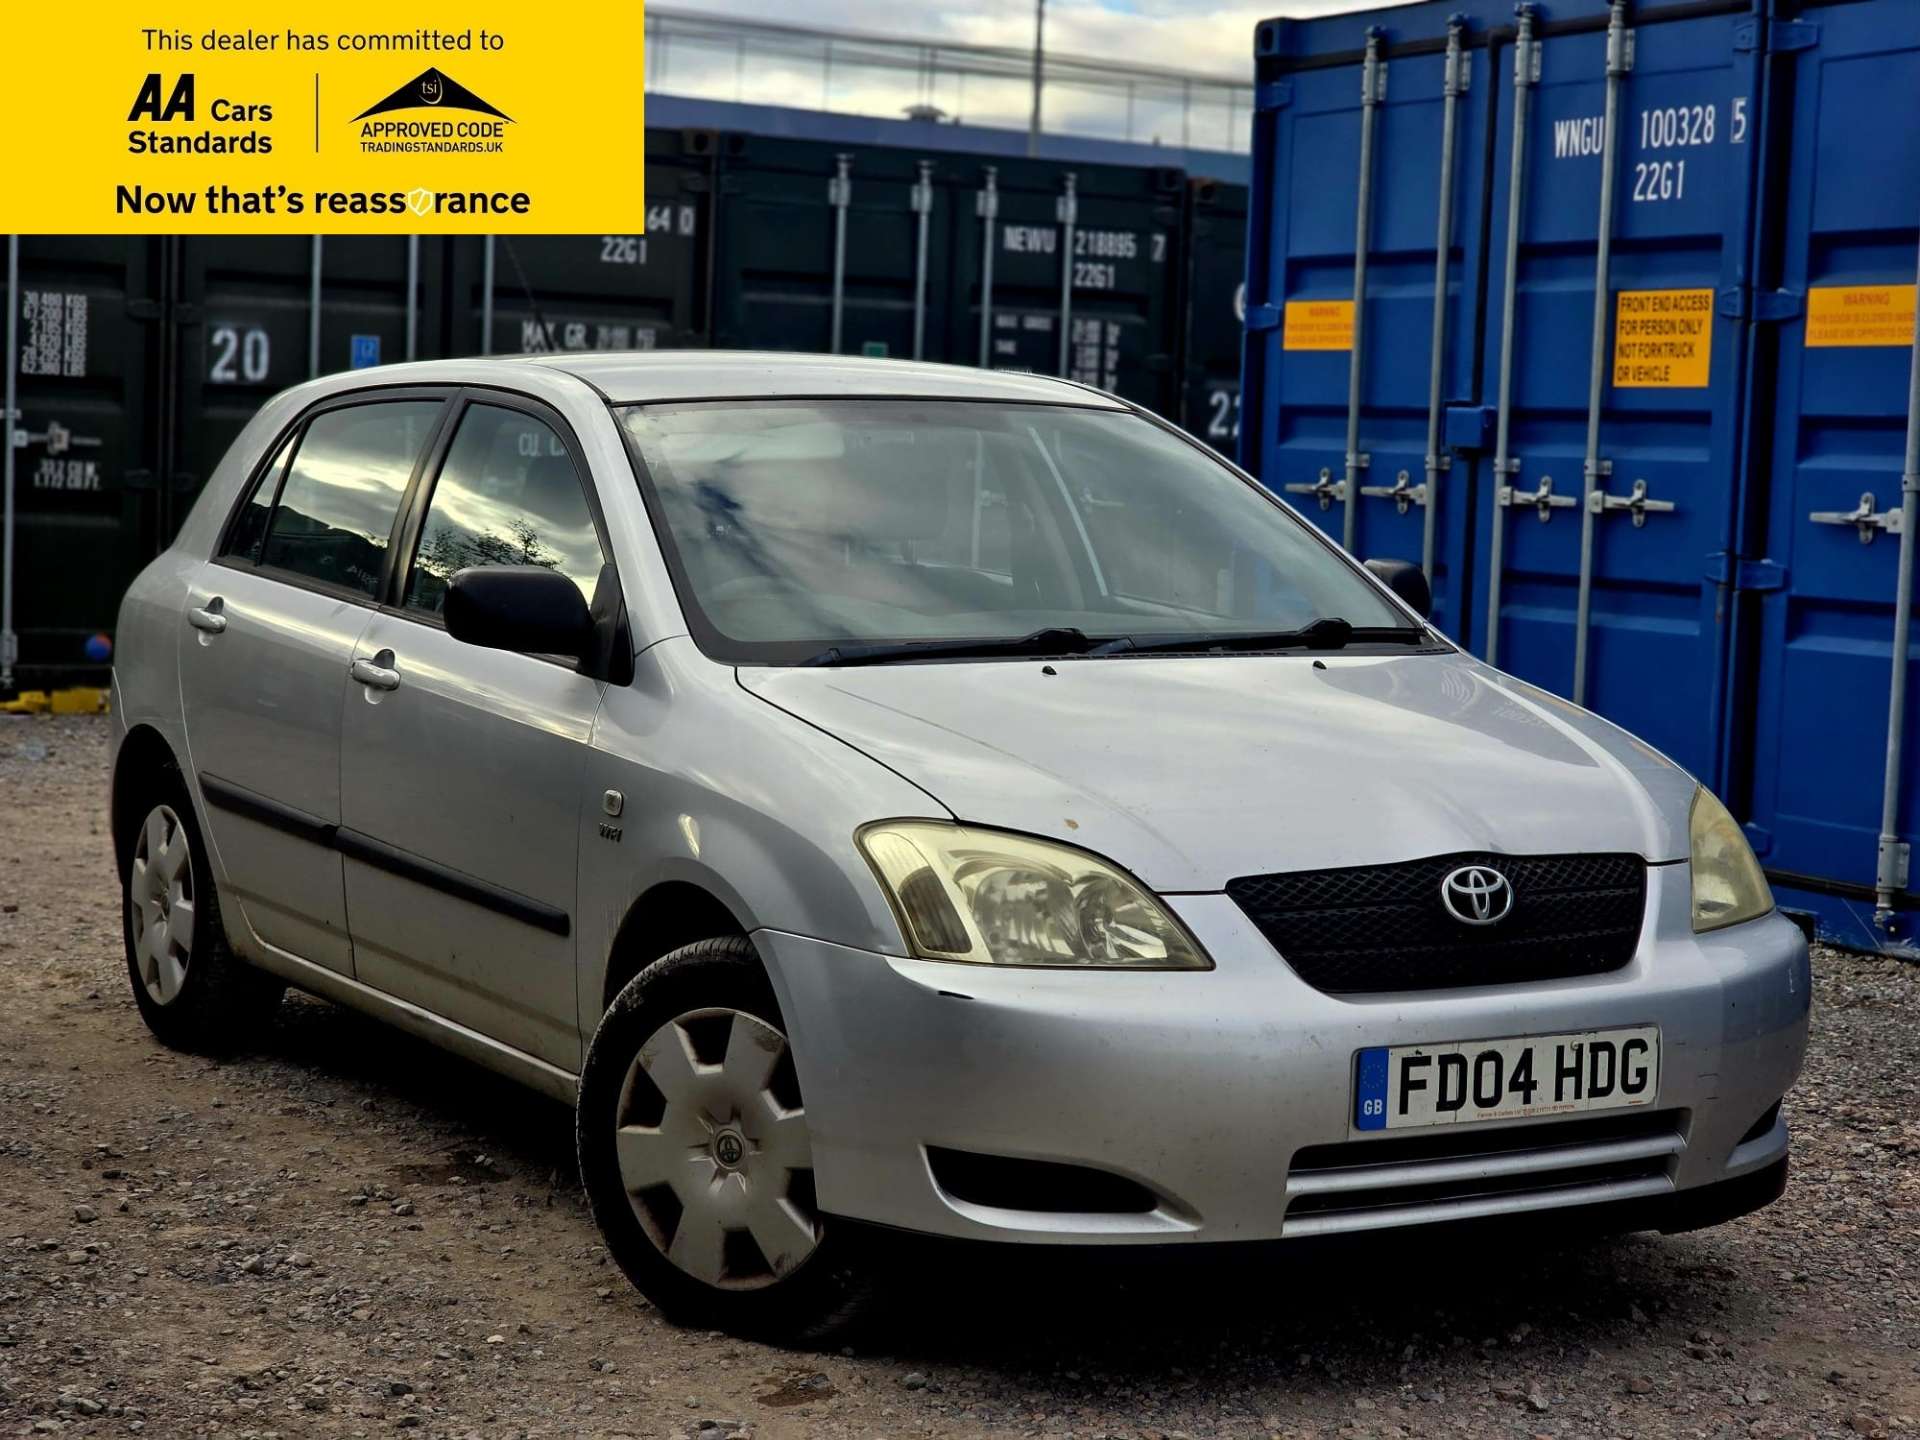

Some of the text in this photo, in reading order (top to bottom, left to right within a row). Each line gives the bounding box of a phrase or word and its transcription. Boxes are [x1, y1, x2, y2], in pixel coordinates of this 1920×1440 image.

[1554, 98, 1747, 158] WNGU 100328 5
[1633, 160, 1685, 201] 22G1
[601, 235, 647, 264] 22G1
[1004, 226, 1057, 253] NEWU
[1075, 230, 1137, 258] 218895
[1074, 262, 1115, 288] 22G1
[1621, 294, 1710, 313] FRONT END ACCESS
[1619, 319, 1704, 335] FOR PERSON ONLY
[210, 328, 270, 382] 20
[1617, 365, 1671, 382] OR VEHICLE
[1363, 1038, 1649, 1116] GB FD04 HDG
